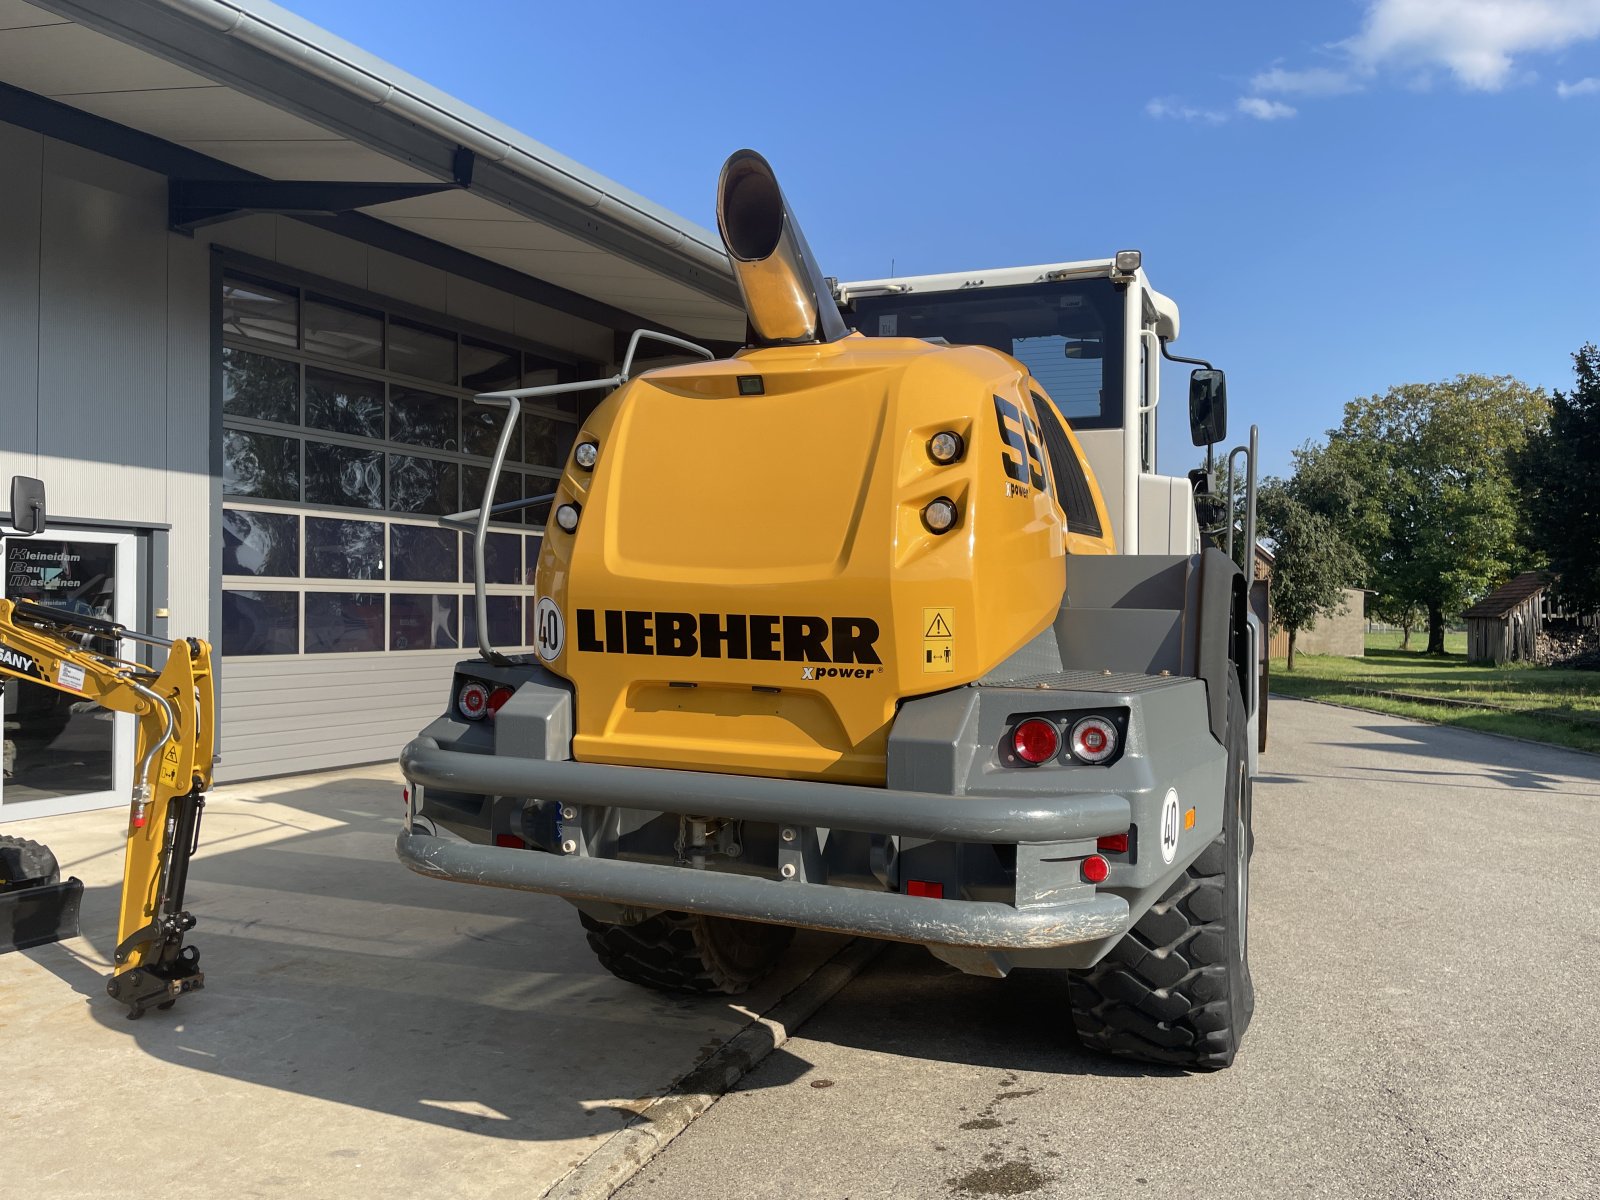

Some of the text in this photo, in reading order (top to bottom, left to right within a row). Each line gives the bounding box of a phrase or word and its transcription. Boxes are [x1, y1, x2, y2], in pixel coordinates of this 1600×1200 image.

[9, 548, 80, 562] Kleineidam
[9, 561, 40, 573] Bau
[539, 608, 558, 651] 40
[576, 608, 883, 665] LIEBHERR
[1164, 801, 1177, 850] 40
